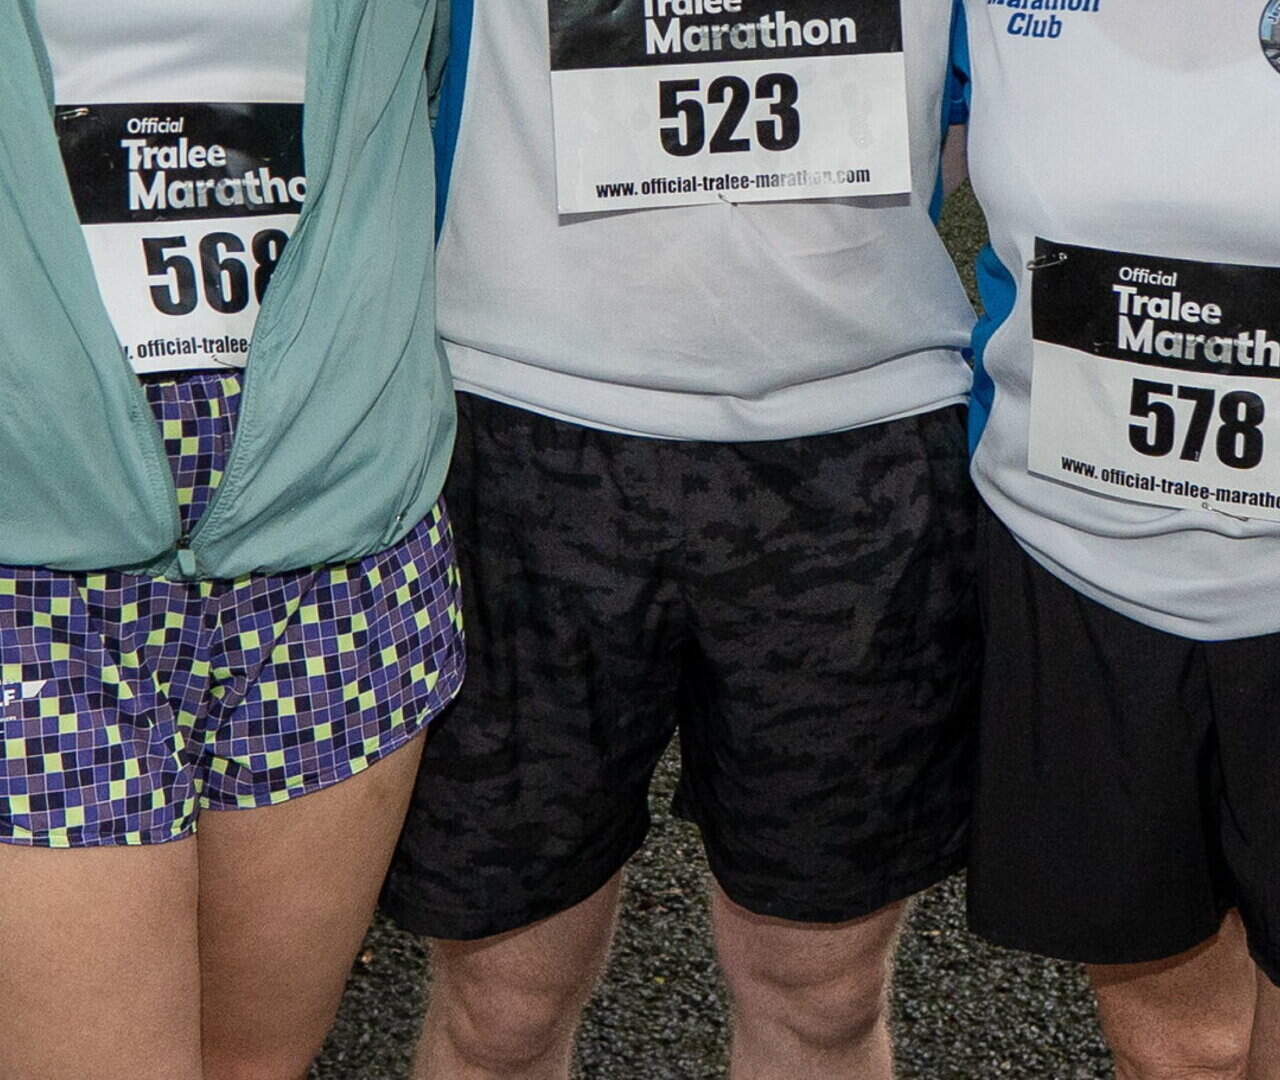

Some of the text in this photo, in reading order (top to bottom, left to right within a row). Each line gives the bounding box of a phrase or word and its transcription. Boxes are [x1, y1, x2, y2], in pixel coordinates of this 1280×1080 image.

[646, 11, 857, 55] Marathon
[1007, 12, 1063, 39] Club
[127, 117, 184, 135] Official
[657, 73, 801, 157] 523
[121, 137, 226, 172] Tralee
[128, 167, 307, 211] Maratho
[596, 181, 638, 199] www.
[140, 229, 289, 316] 568
[1118, 266, 1178, 287] Official
[1112, 284, 1222, 325] Tralee
[137, 335, 251, 359] official-tralee-
[1128, 377, 1265, 470] 578
[1061, 456, 1098, 480] www.
